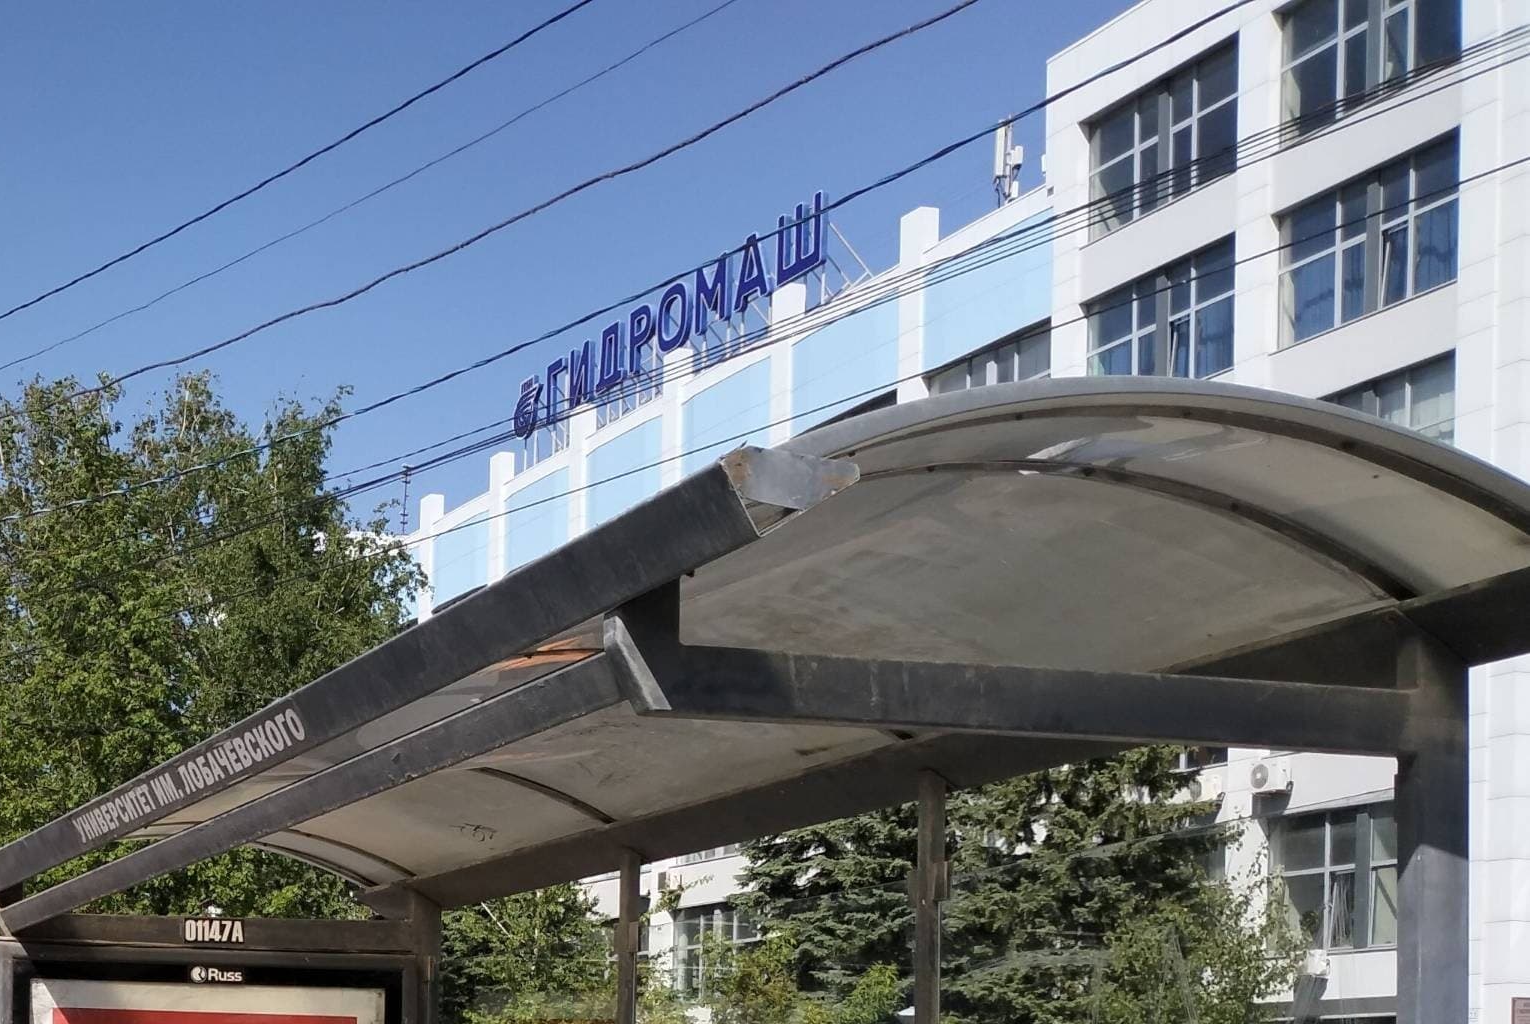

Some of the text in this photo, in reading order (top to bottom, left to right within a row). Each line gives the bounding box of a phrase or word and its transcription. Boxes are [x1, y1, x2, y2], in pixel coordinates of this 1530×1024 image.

[546, 190, 827, 425] ГИДРОМАШ
[72, 708, 306, 844] УНИВЕРСИТЕТ ИМ. ЛОБАЧЕВСКОГО
[207, 967, 243, 982] Russ
